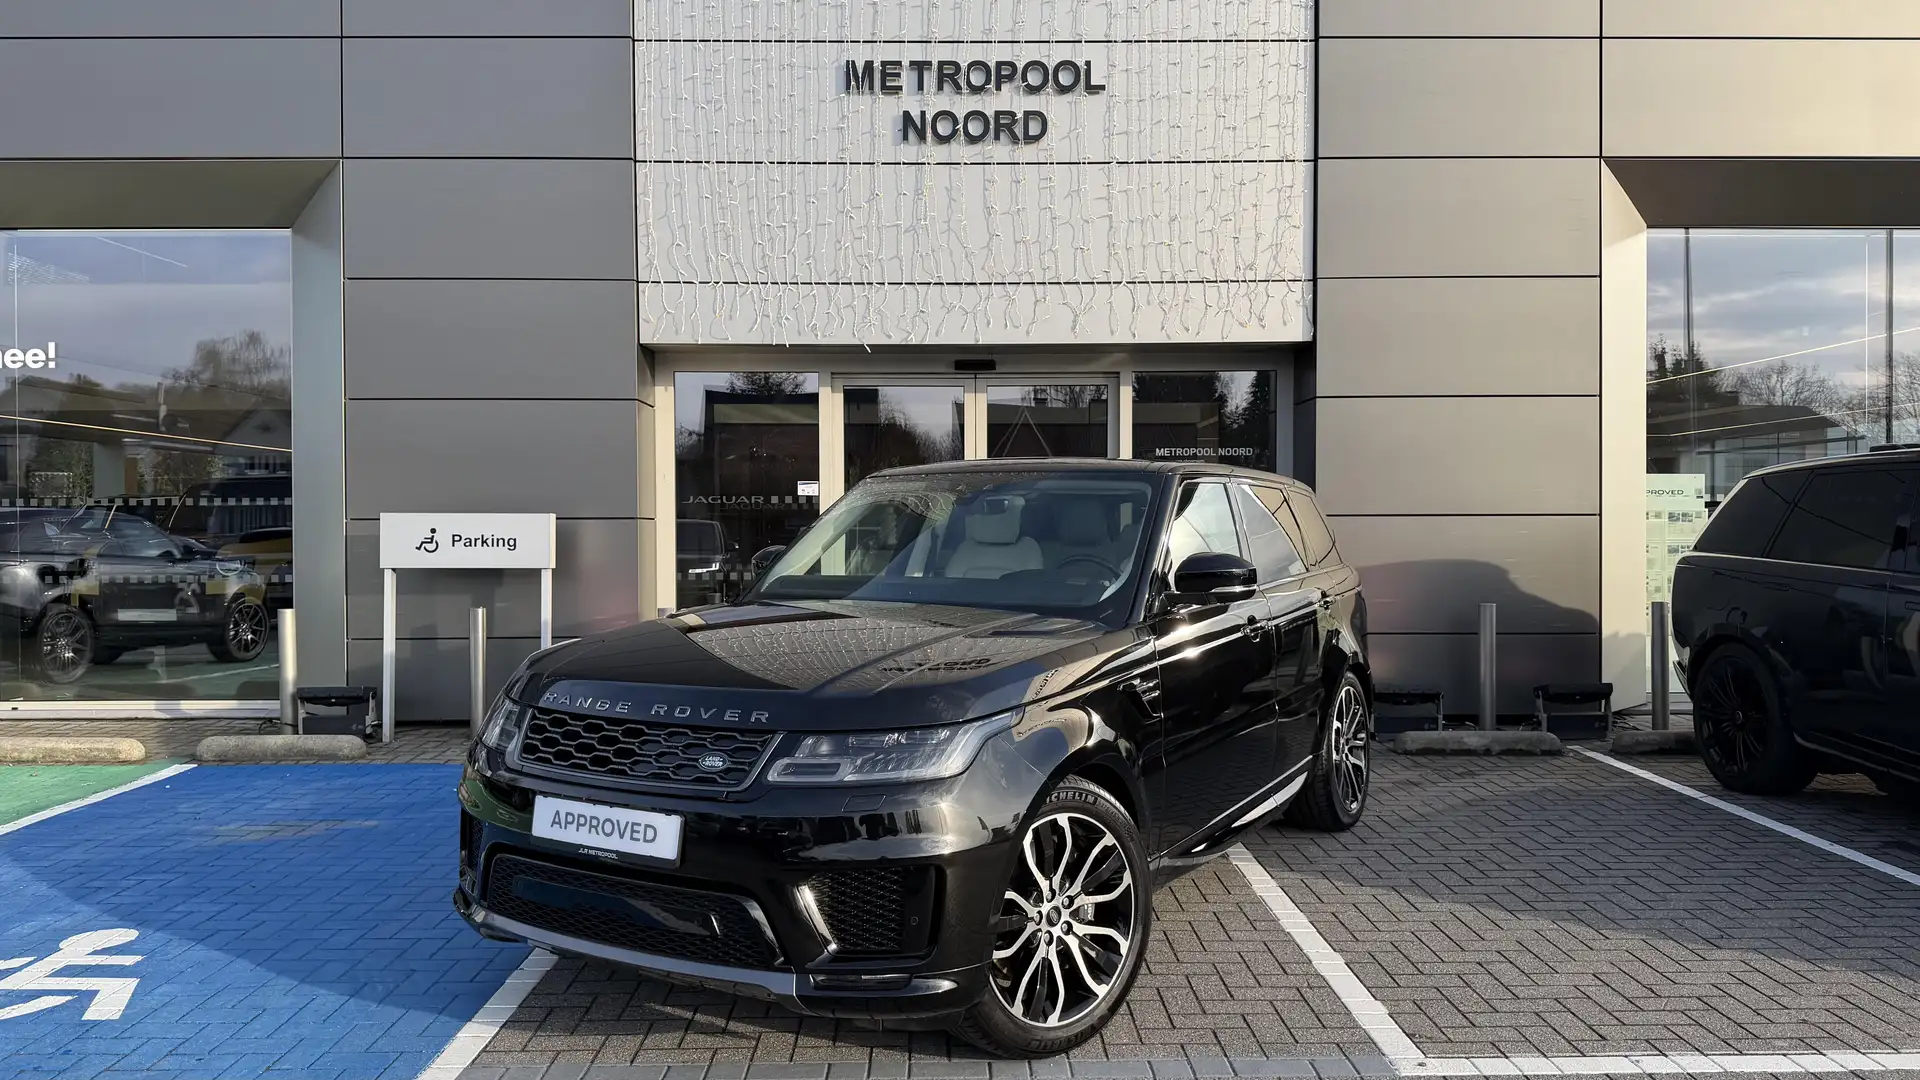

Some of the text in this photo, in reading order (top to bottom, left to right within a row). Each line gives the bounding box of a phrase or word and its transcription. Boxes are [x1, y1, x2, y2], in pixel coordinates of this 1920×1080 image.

[845, 60, 1106, 92] METROPOOL
[902, 110, 1048, 143] NOORD
[0, 341, 56, 369] ee!
[1155, 447, 1254, 457] METROPOOL NOORD
[682, 495, 764, 504] JAGUAR
[451, 533, 517, 551] Parking
[543, 691, 769, 723] RANGE ROVER
[1046, 791, 1096, 804] ICHELIN
[551, 810, 658, 844] APPROVED
[589, 849, 618, 859] METROPOOL
